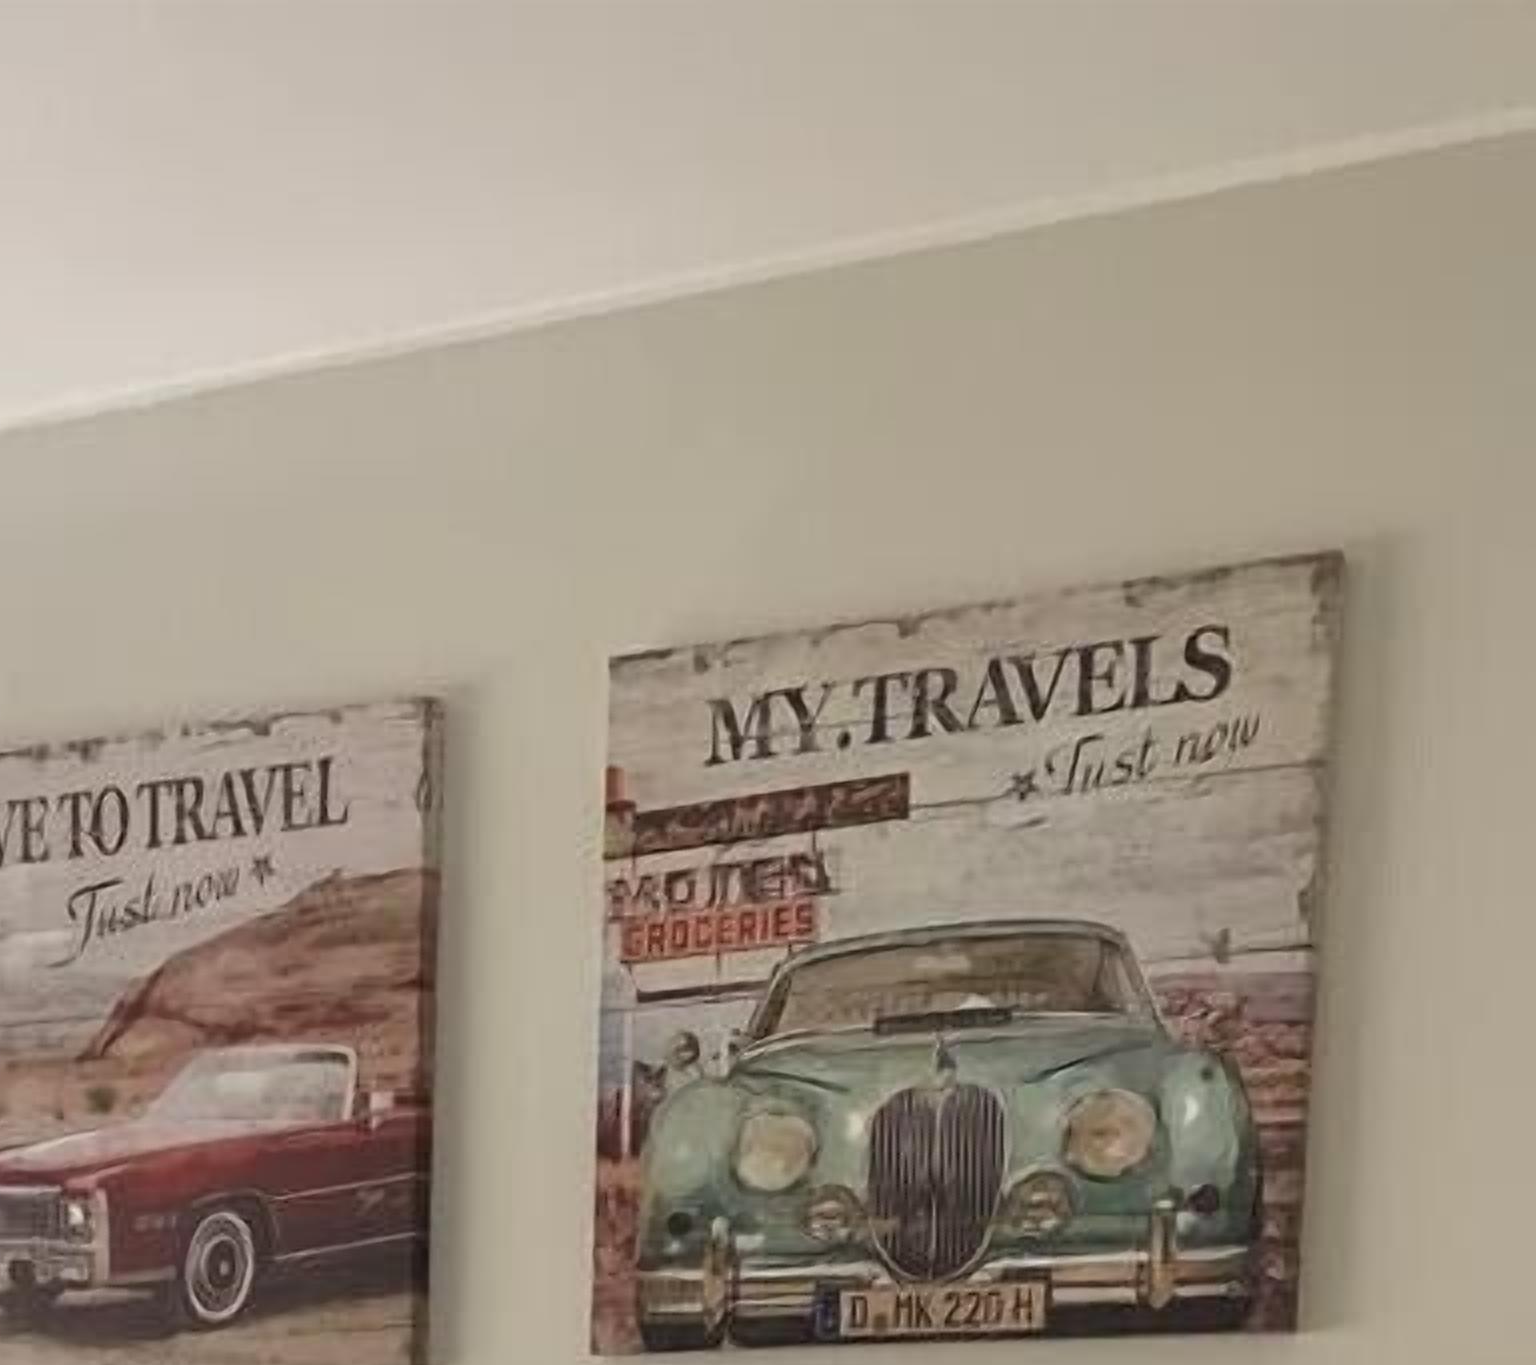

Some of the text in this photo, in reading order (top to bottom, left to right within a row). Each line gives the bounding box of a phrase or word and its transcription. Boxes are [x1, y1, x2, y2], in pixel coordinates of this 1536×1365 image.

[1044, 711, 1261, 795] Just now
[55, 784, 130, 858] TO
[136, 756, 349, 849] TRAVEL
[46, 867, 240, 968] Just now
[621, 902, 815, 958] GROCERIES
[849, 1294, 868, 1329] D
[944, 1291, 1002, 1328] 220
[1014, 1287, 1034, 1323] H
